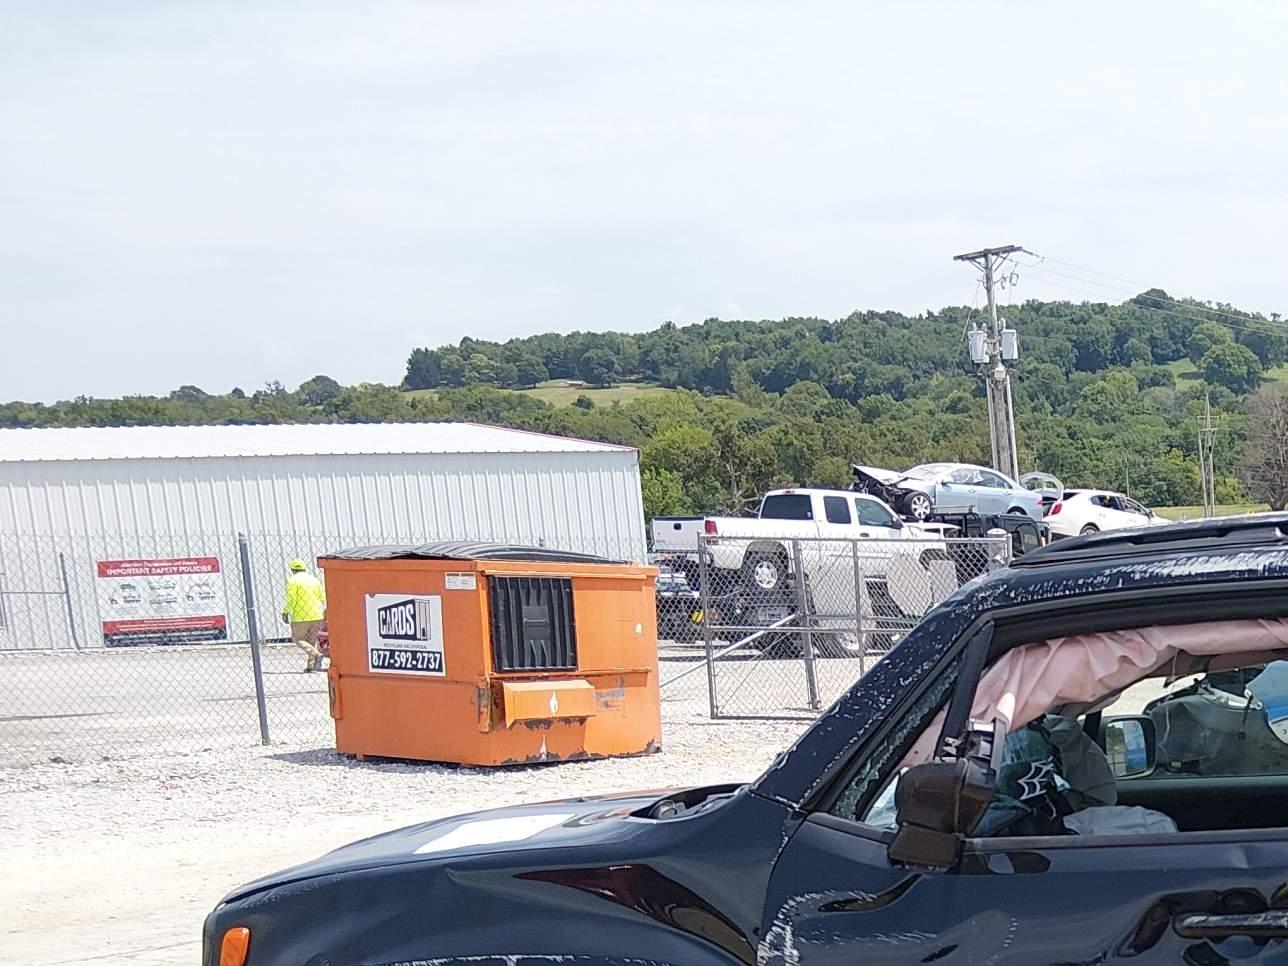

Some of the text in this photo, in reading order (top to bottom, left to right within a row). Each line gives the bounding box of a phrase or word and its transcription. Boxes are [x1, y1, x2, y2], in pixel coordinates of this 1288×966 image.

[107, 566, 150, 576] IMPORTANT
[151, 565, 178, 575] SAFETY
[179, 564, 212, 573] POLICIES
[380, 603, 415, 635] CARDS
[372, 650, 441, 670] 877-592-2737
